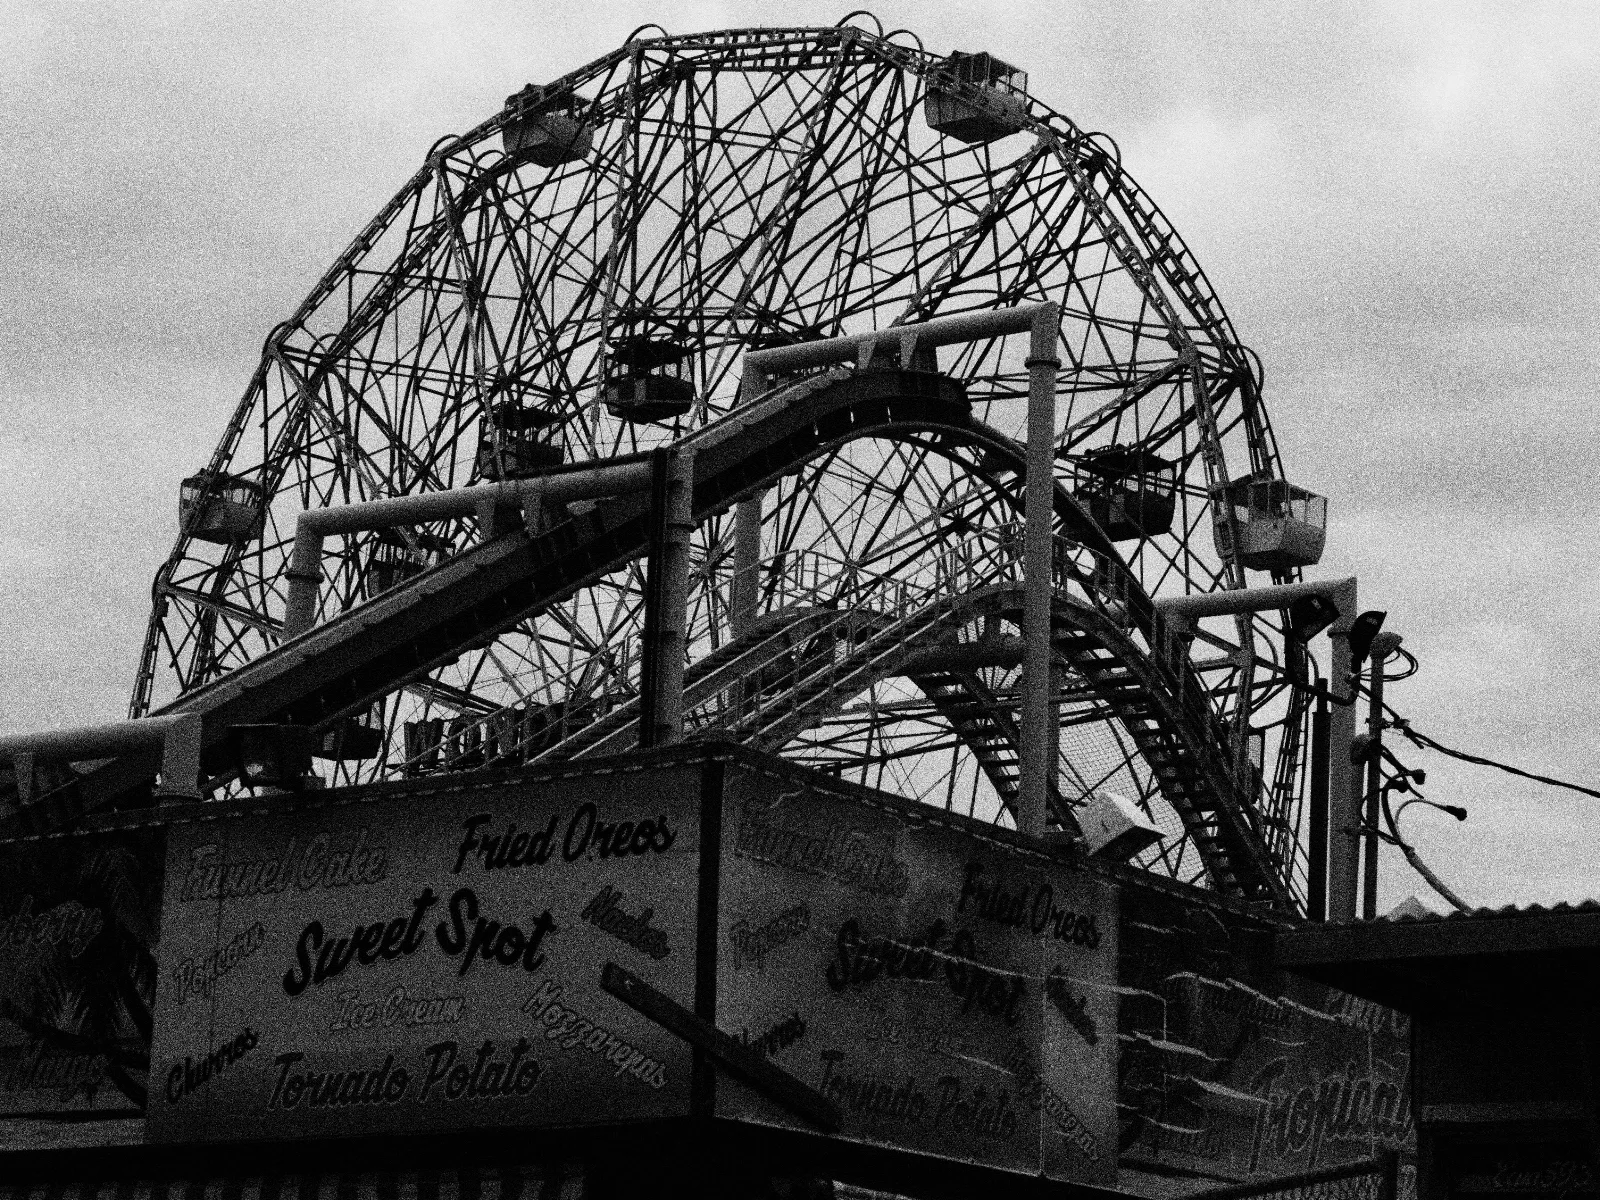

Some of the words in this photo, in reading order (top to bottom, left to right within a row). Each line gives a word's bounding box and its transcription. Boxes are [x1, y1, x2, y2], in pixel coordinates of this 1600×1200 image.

[181, 835, 297, 902] Funnel
[298, 827, 389, 890] Cake
[453, 814, 560, 873] Fried
[563, 803, 677, 863] Oreos
[283, 887, 439, 996] Sweet
[436, 887, 556, 976] Spot
[581, 885, 670, 960] Nachos
[958, 862, 1030, 930] Fried
[1031, 885, 1101, 949] Oreos
[330, 989, 376, 1031] Ice
[382, 985, 466, 1028] Cream
[826, 919, 946, 992] Sweet
[944, 930, 1027, 1027] Spot
[165, 1027, 260, 1105] Churros
[267, 1051, 408, 1112] Tornado
[420, 1036, 544, 1104] Potato
[523, 980, 670, 1090] Mozzarepas
[820, 1050, 926, 1122] Tornado
[933, 1075, 1017, 1140] Potato
